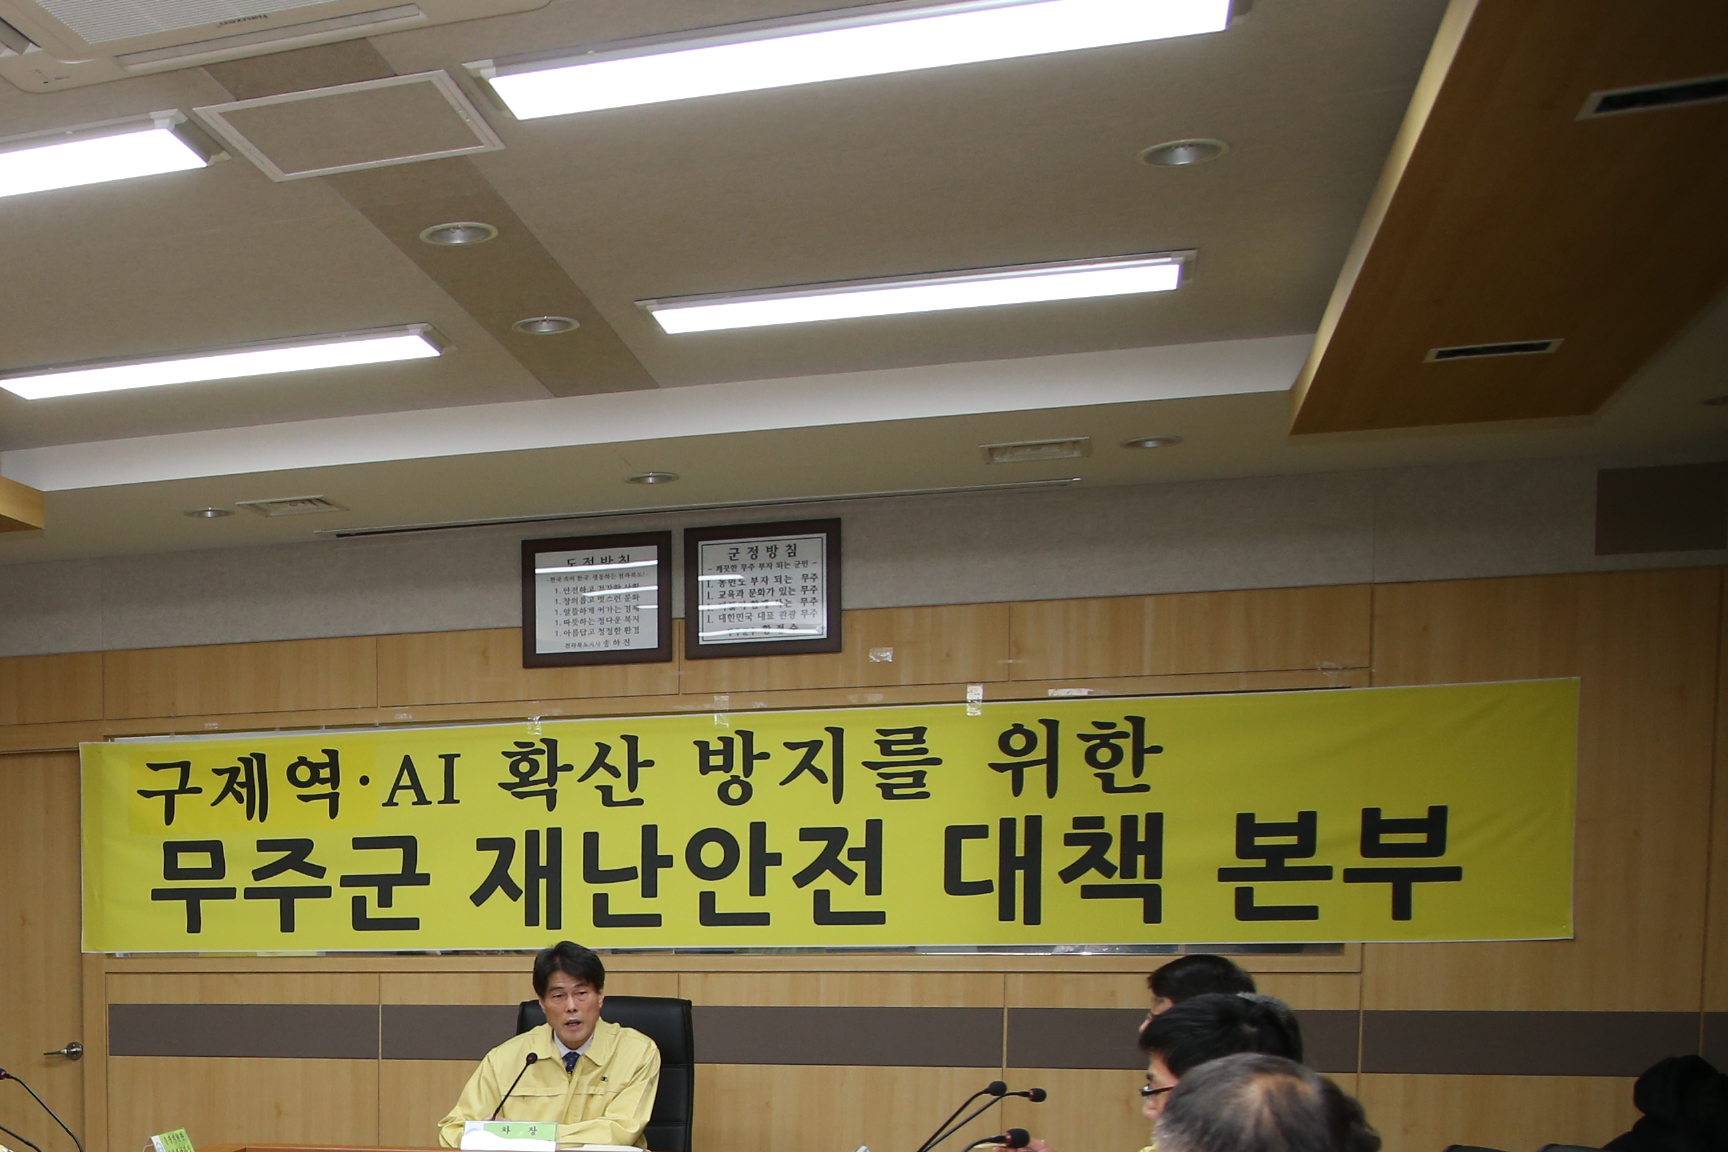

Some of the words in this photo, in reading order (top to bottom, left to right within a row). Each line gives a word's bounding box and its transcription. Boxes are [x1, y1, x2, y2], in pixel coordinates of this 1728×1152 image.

[751, 576, 769, 585] 부자
[774, 575, 793, 584] 되는
[801, 573, 818, 583] 무주
[779, 586, 796, 596] 있는
[801, 585, 818, 595] 무주
[800, 597, 818, 606] 무주
[718, 613, 753, 623] 대한민국
[758, 612, 775, 621] 대표
[801, 609, 818, 618] 무주
[497, 734, 655, 812] 확산
[692, 726, 943, 806] 방지를
[987, 715, 1164, 800] 위한
[150, 835, 431, 934] 무주군
[469, 818, 886, 931] 재난안전
[943, 811, 1164, 926] 대책
[1217, 804, 1464, 922] 본부
